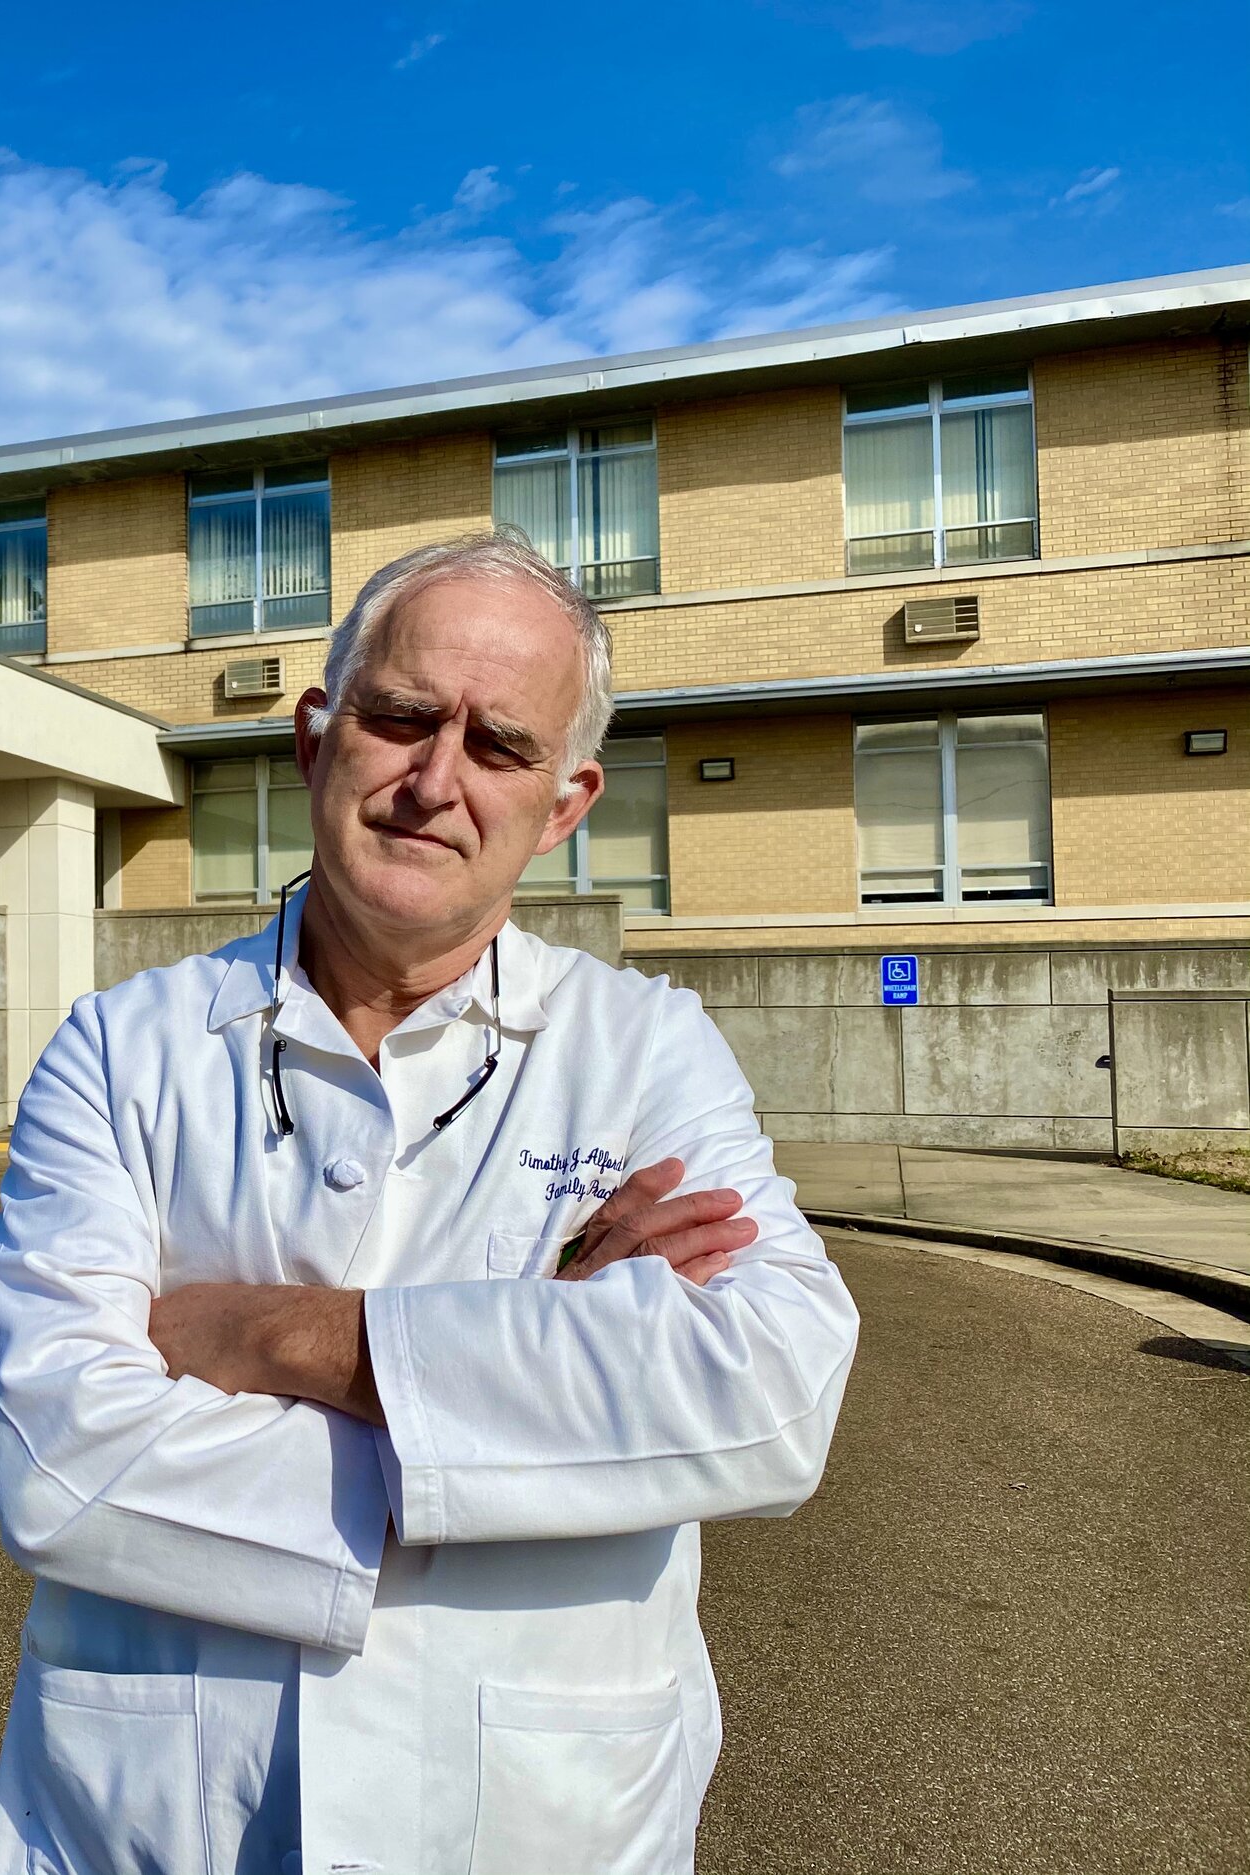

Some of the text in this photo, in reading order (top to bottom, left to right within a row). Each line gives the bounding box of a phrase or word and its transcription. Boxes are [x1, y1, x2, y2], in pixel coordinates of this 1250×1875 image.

[519, 1149, 568, 1175] Timothy
[584, 1147, 623, 1174] Alford
[545, 1177, 585, 1202] Family
